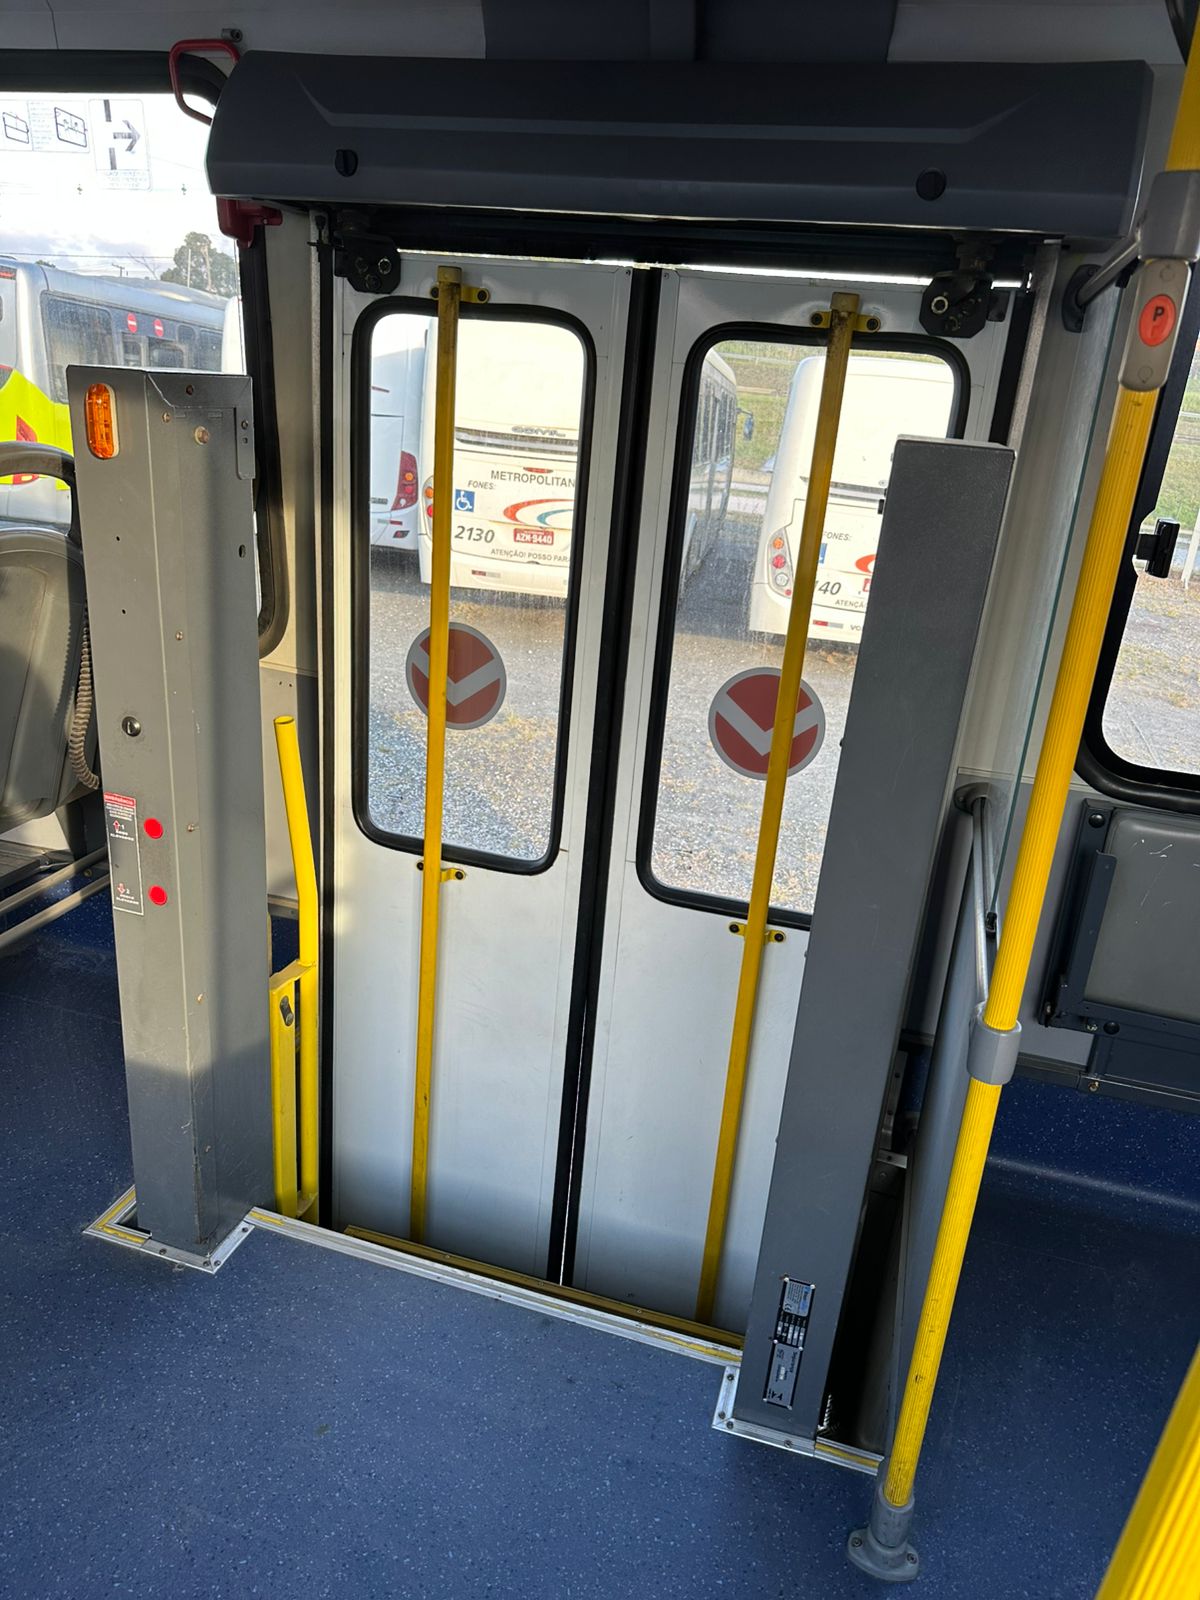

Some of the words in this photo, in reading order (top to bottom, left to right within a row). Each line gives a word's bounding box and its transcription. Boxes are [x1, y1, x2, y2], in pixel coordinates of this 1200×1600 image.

[1152, 306, 1165, 322] P
[467, 480, 497, 490] FONES:
[454, 525, 495, 544] 2130
